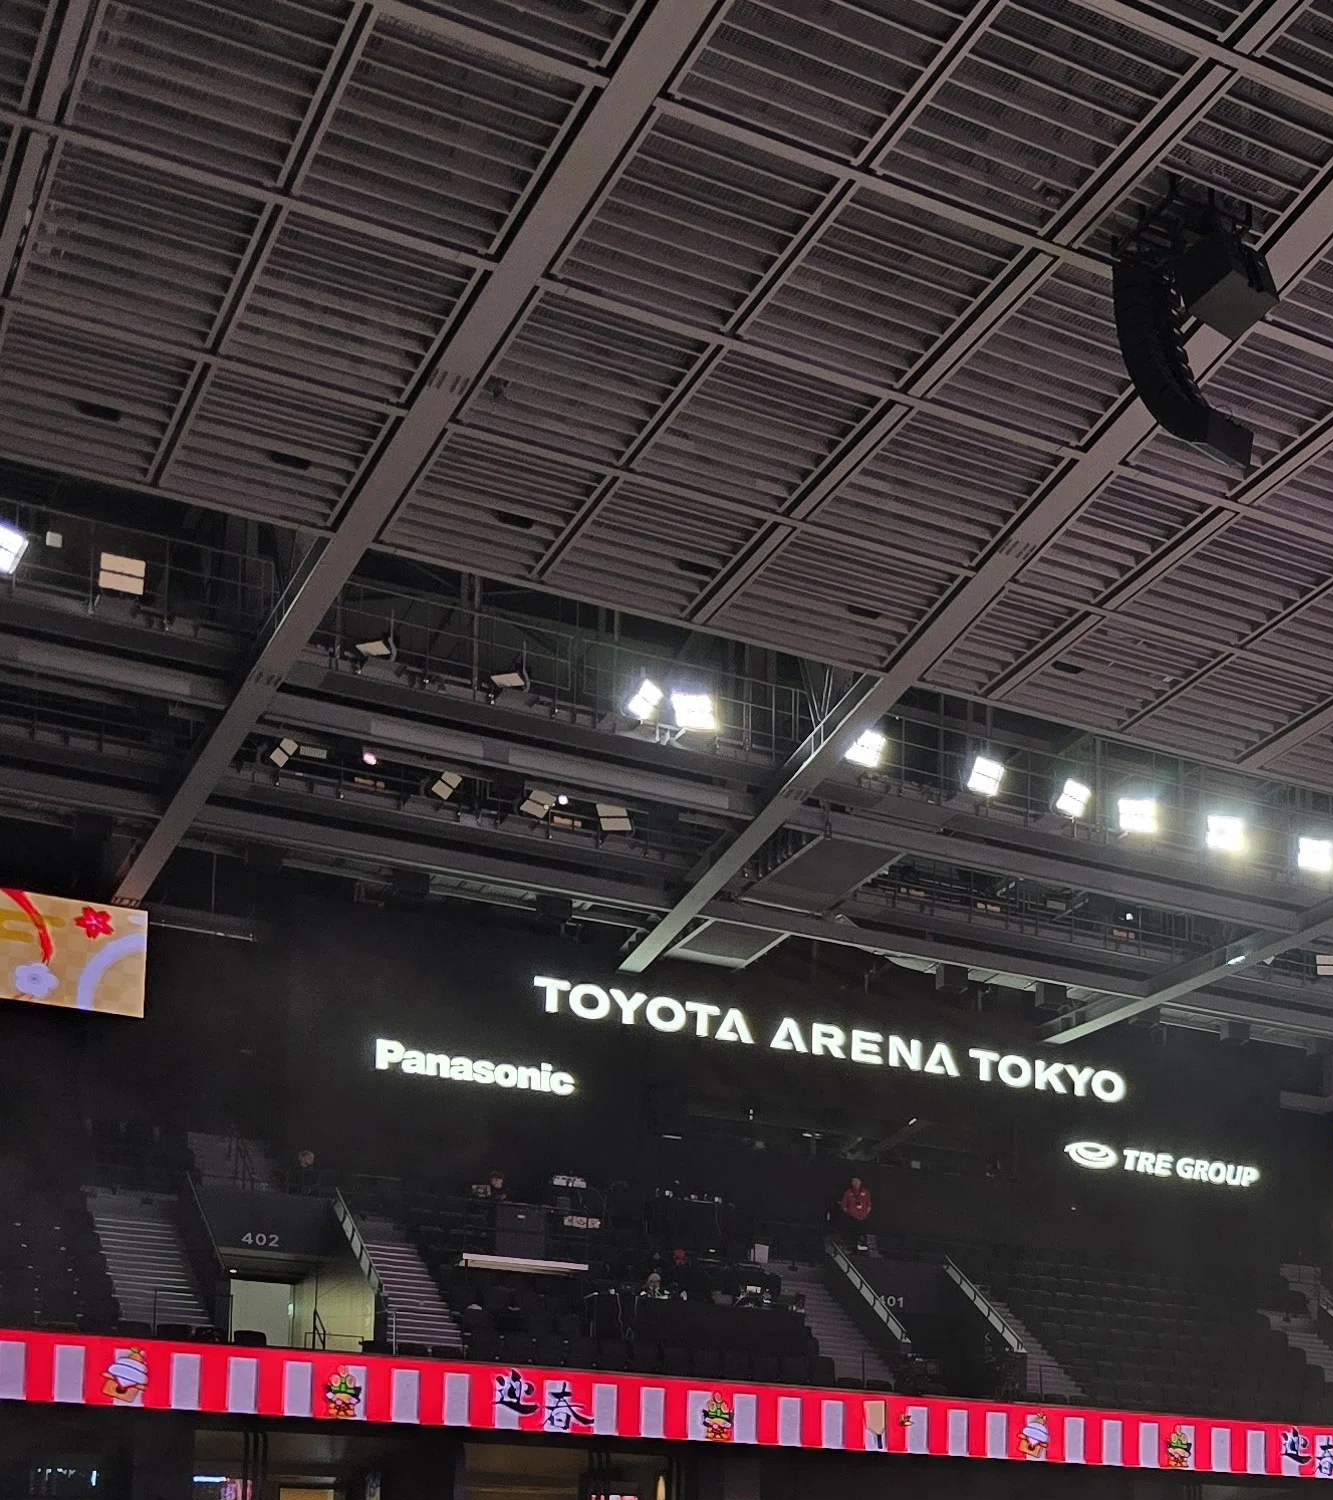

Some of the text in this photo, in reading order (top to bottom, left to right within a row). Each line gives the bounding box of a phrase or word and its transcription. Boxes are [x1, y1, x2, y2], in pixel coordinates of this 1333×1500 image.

[375, 1037, 576, 1096] Panasonic
[533, 974, 1126, 1104] TOYOTA ARENA TOKYO
[1122, 1148, 1259, 1188] TRE GROUP
[241, 1232, 280, 1248] 402
[494, 1368, 594, 1431] 迎春
